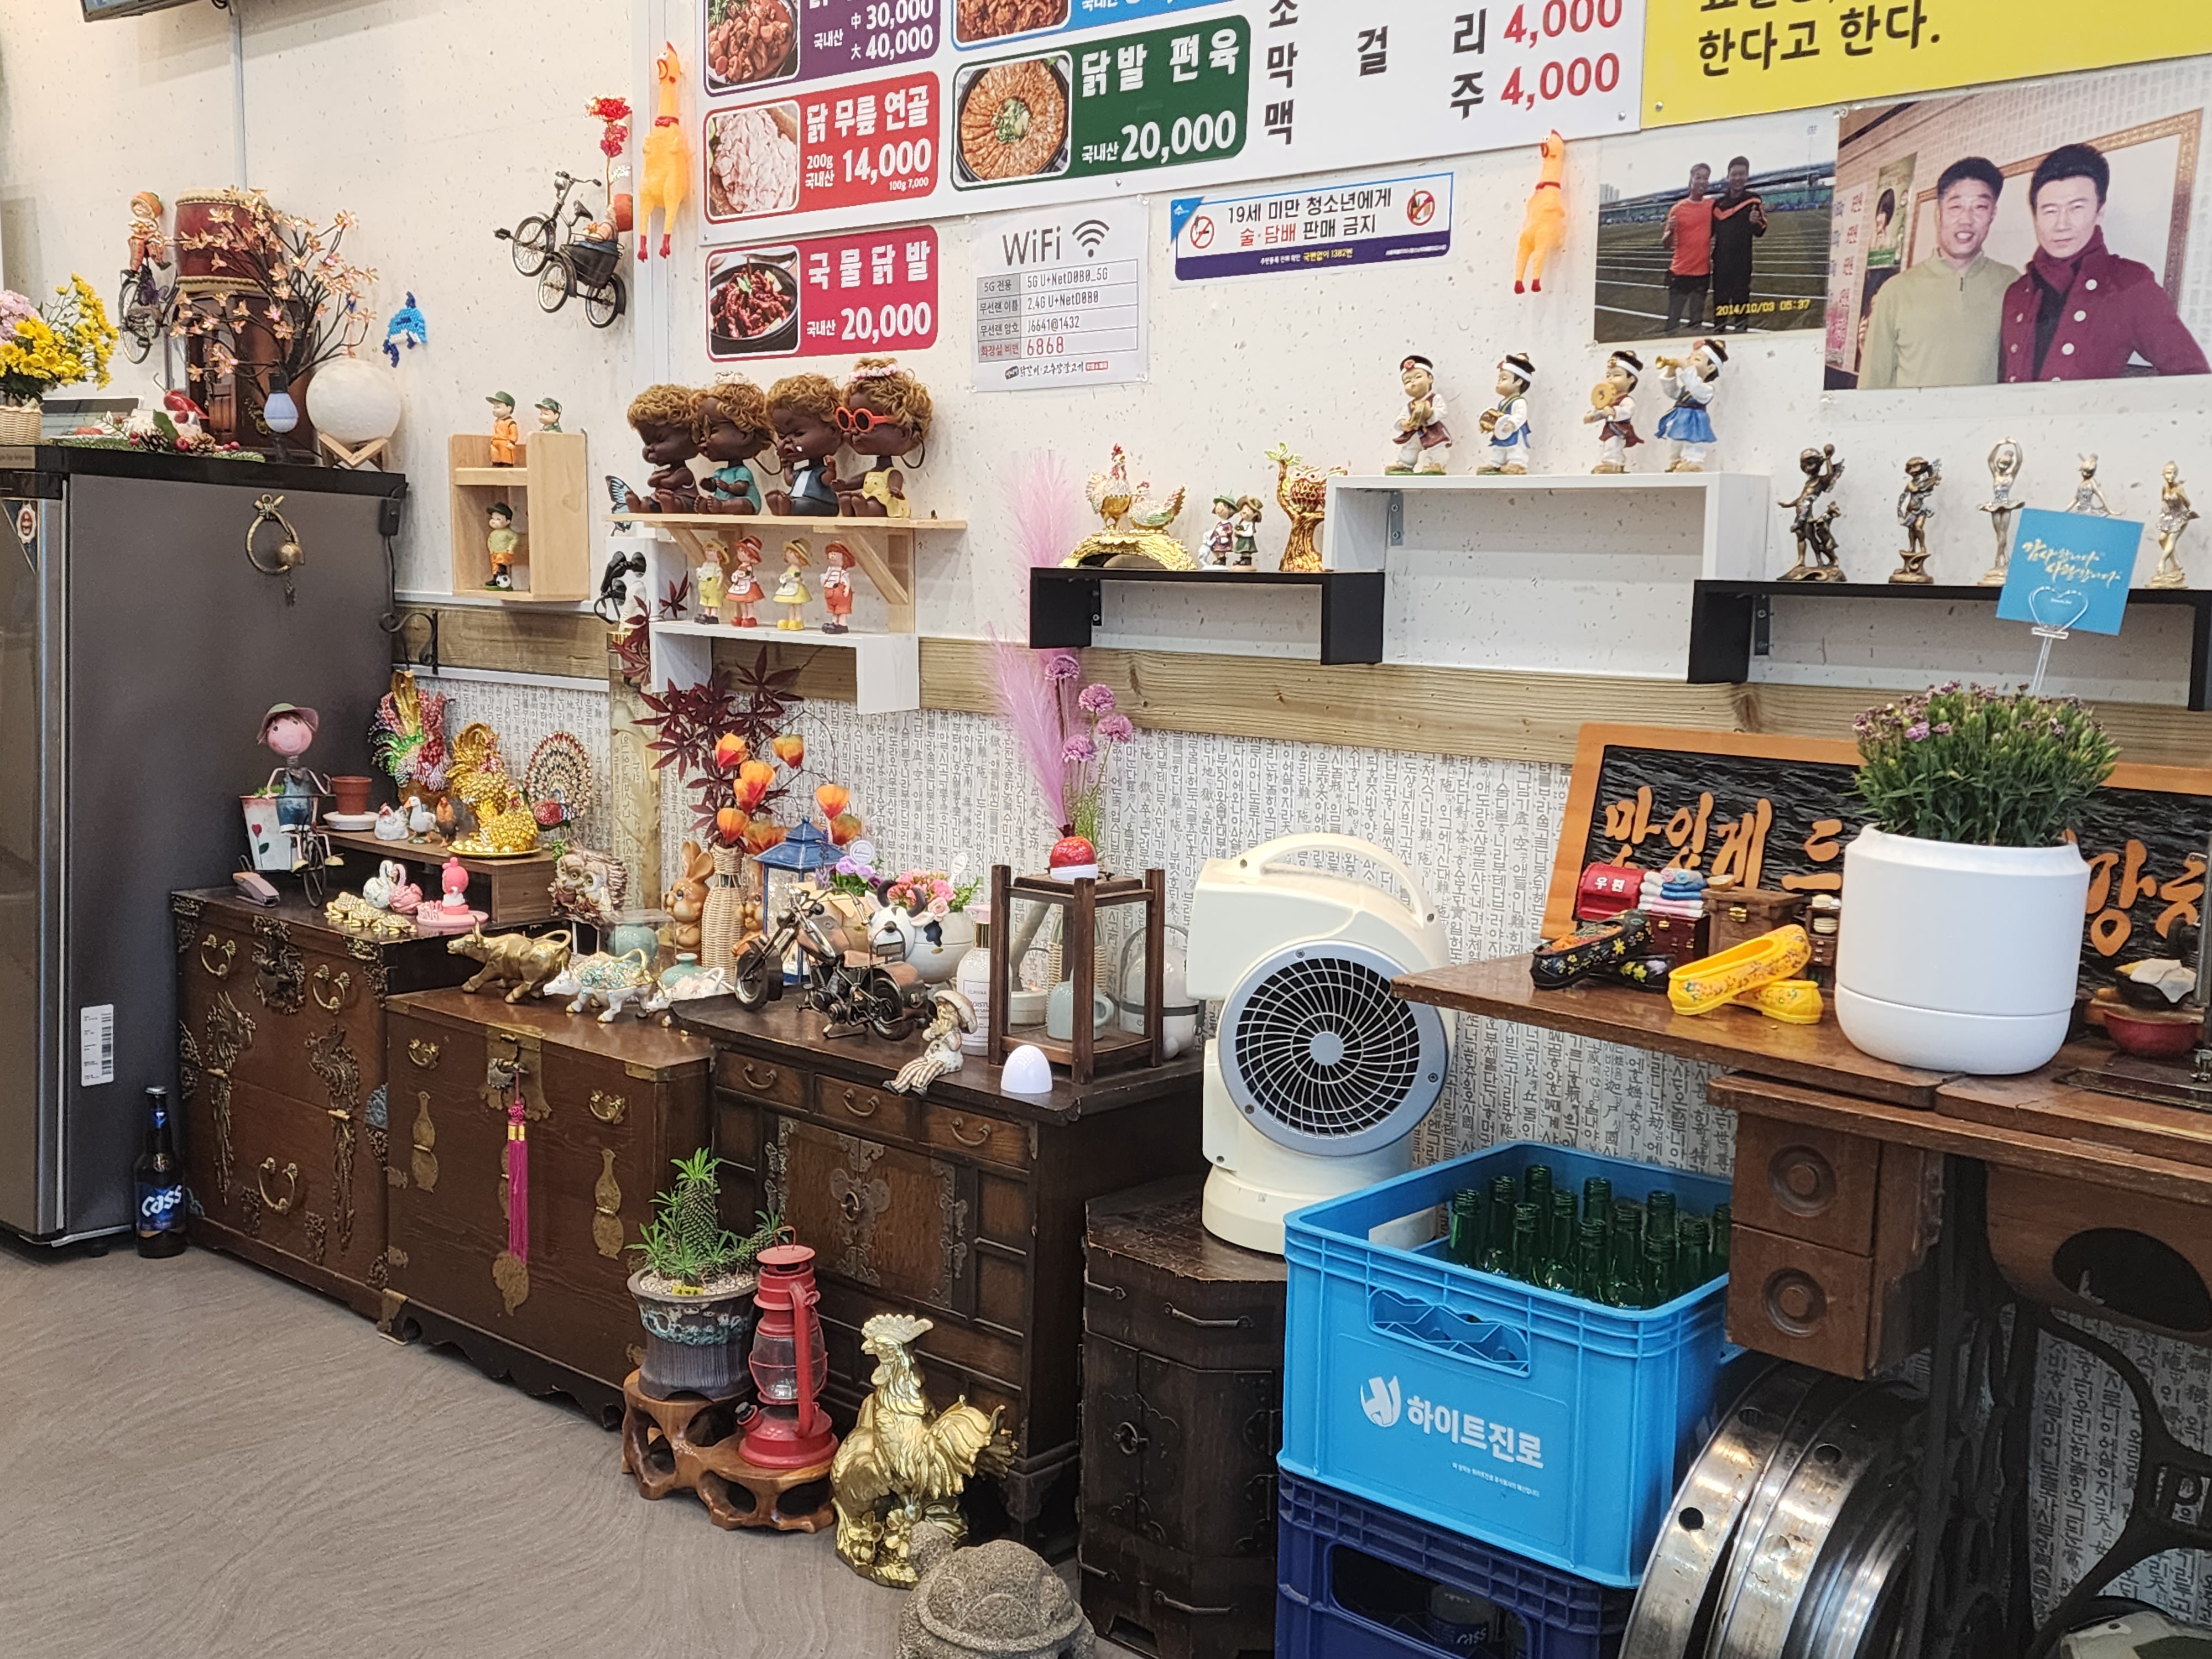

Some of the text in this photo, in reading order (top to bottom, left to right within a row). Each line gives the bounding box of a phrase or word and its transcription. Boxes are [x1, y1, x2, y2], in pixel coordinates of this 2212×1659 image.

[866, 0, 933, 30] 30,000
[1503, 0, 1622, 49] 4,000
[813, 28, 843, 50] 국내산
[851, 24, 933, 61] 大 40,000
[1698, 0, 1940, 77] 한다고 한다.
[1500, 52, 1620, 111] 4,000
[807, 85, 930, 144] 닭 무릎 연골
[1082, 110, 1236, 164] 국내산 20,000
[805, 138, 932, 190] 국내산 14,000
[806, 153, 833, 170] 200g
[889, 176, 929, 191] 100g 7,000
[1228, 187, 1392, 223] 19세 미만 청소년에게
[1302, 217, 1336, 241] 판매
[1343, 213, 1376, 236] 금지
[1002, 225, 1061, 267] WiFi
[984, 281, 995, 292] 5G
[997, 279, 1011, 292] 전용
[1027, 275, 1038, 288] 5G
[806, 301, 932, 345] 국내산 20,000
[979, 301, 1002, 315] 무선랜
[1027, 296, 1045, 310] 2.4G
[1716, 301, 1775, 316] 2014/10/03
[980, 324, 1003, 337] 무선랜
[1004, 322, 1019, 335] 암호
[981, 345, 1003, 357] 화장실
[1027, 336, 1064, 356] 6868
[1406, 1395, 1544, 1469] 하이트진로
